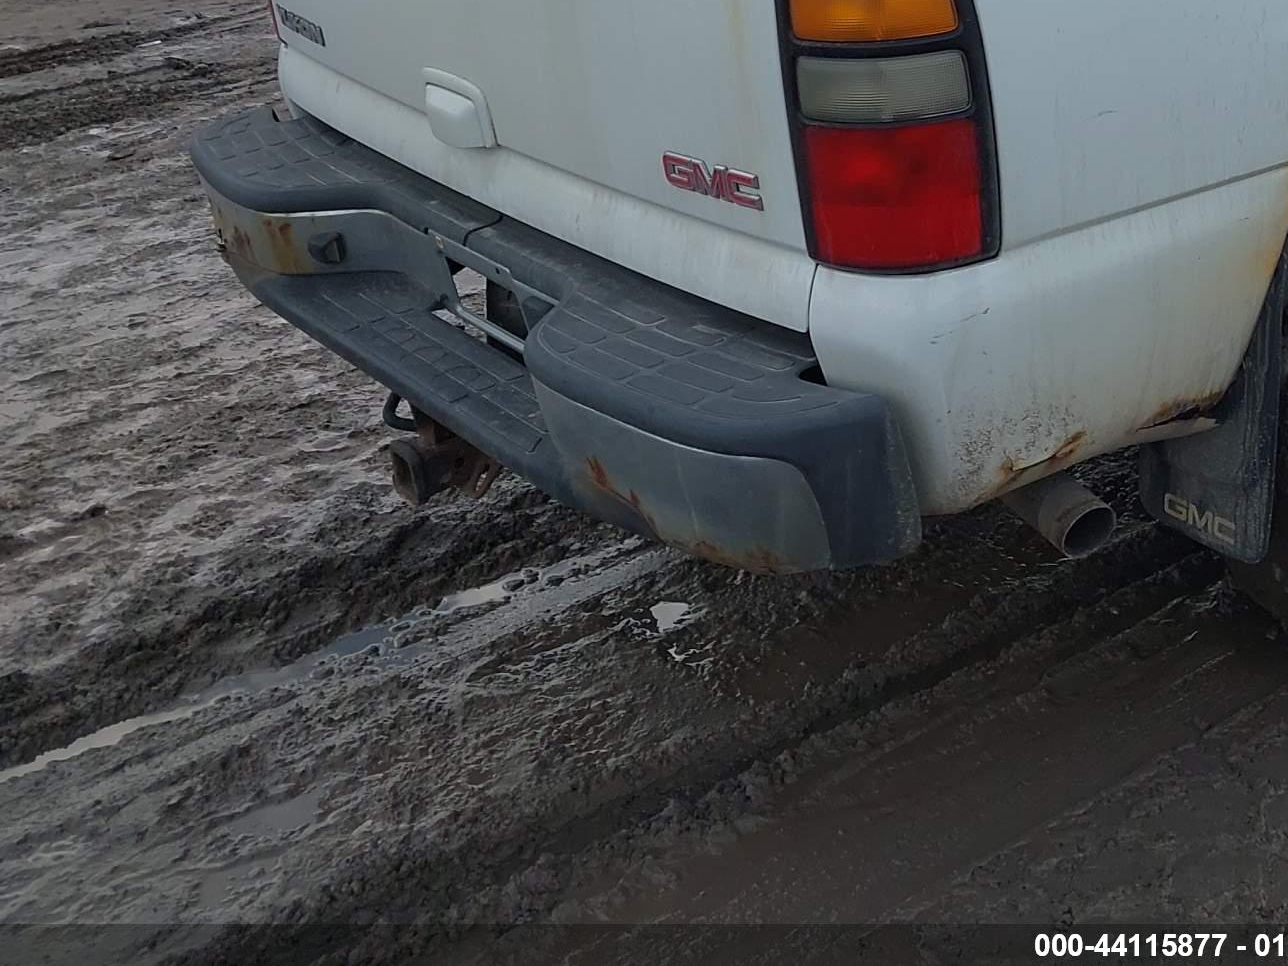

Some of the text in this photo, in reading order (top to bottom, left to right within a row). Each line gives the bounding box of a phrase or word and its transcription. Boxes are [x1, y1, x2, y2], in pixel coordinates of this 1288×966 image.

[275, 3, 327, 47] YUKON
[662, 150, 766, 212] GMC
[1163, 492, 1236, 546] GMC
